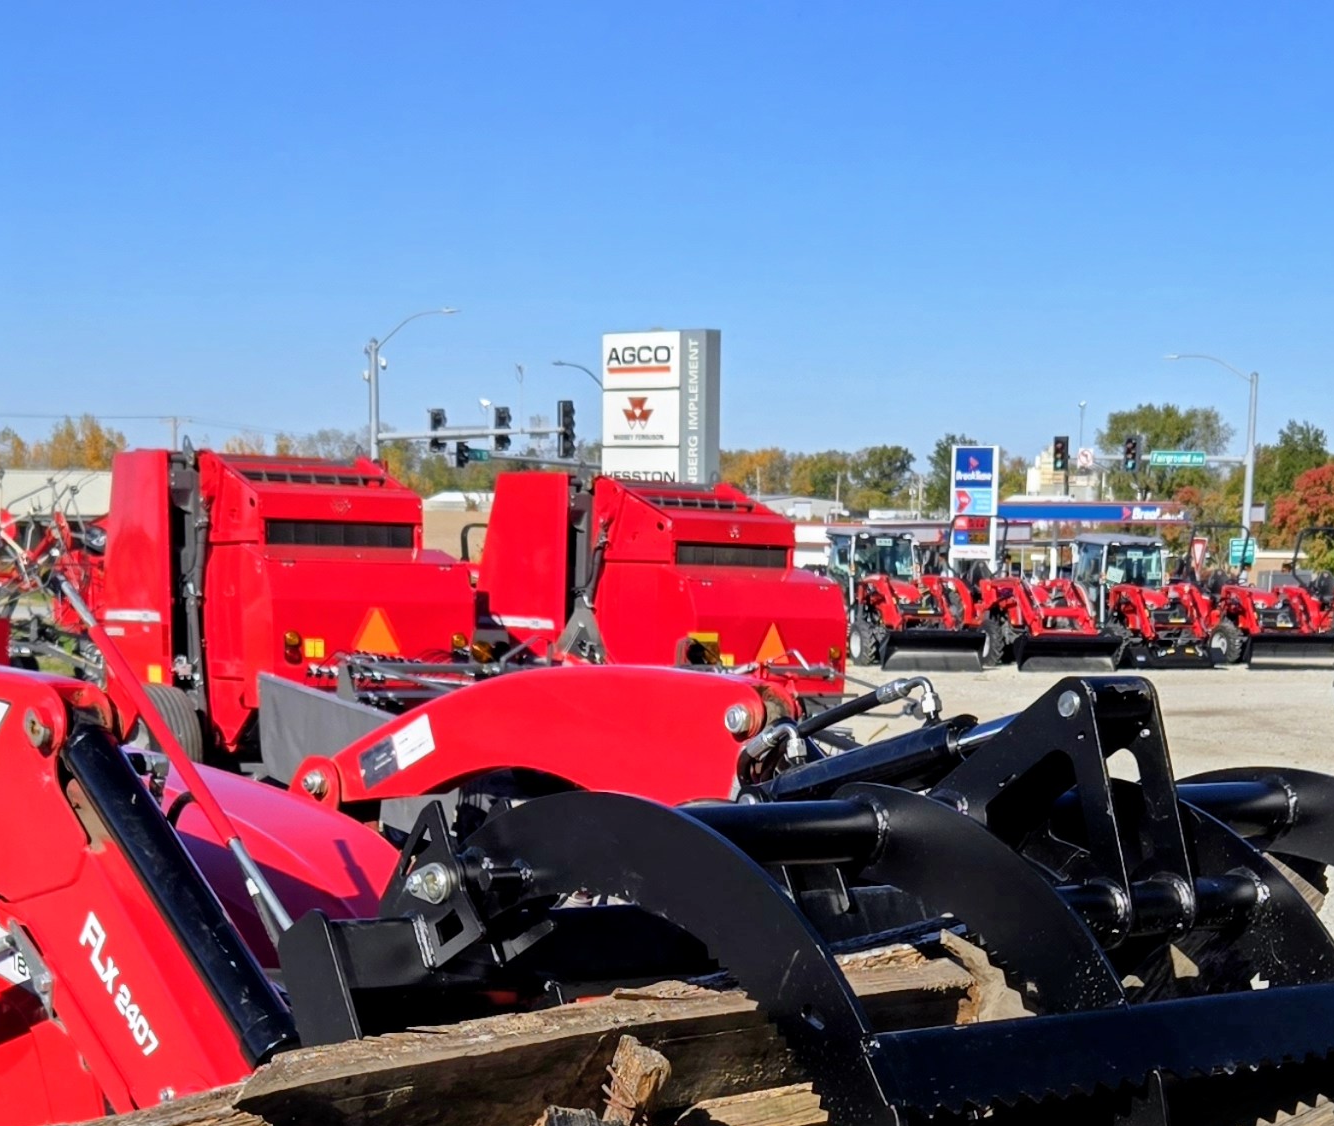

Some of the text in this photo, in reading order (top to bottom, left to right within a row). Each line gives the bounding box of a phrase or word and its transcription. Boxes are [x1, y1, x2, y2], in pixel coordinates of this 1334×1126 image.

[607, 346, 671, 366] AGCO
[688, 338, 699, 430] IMPLEMENT
[79, 911, 159, 1057] FLX 2407
